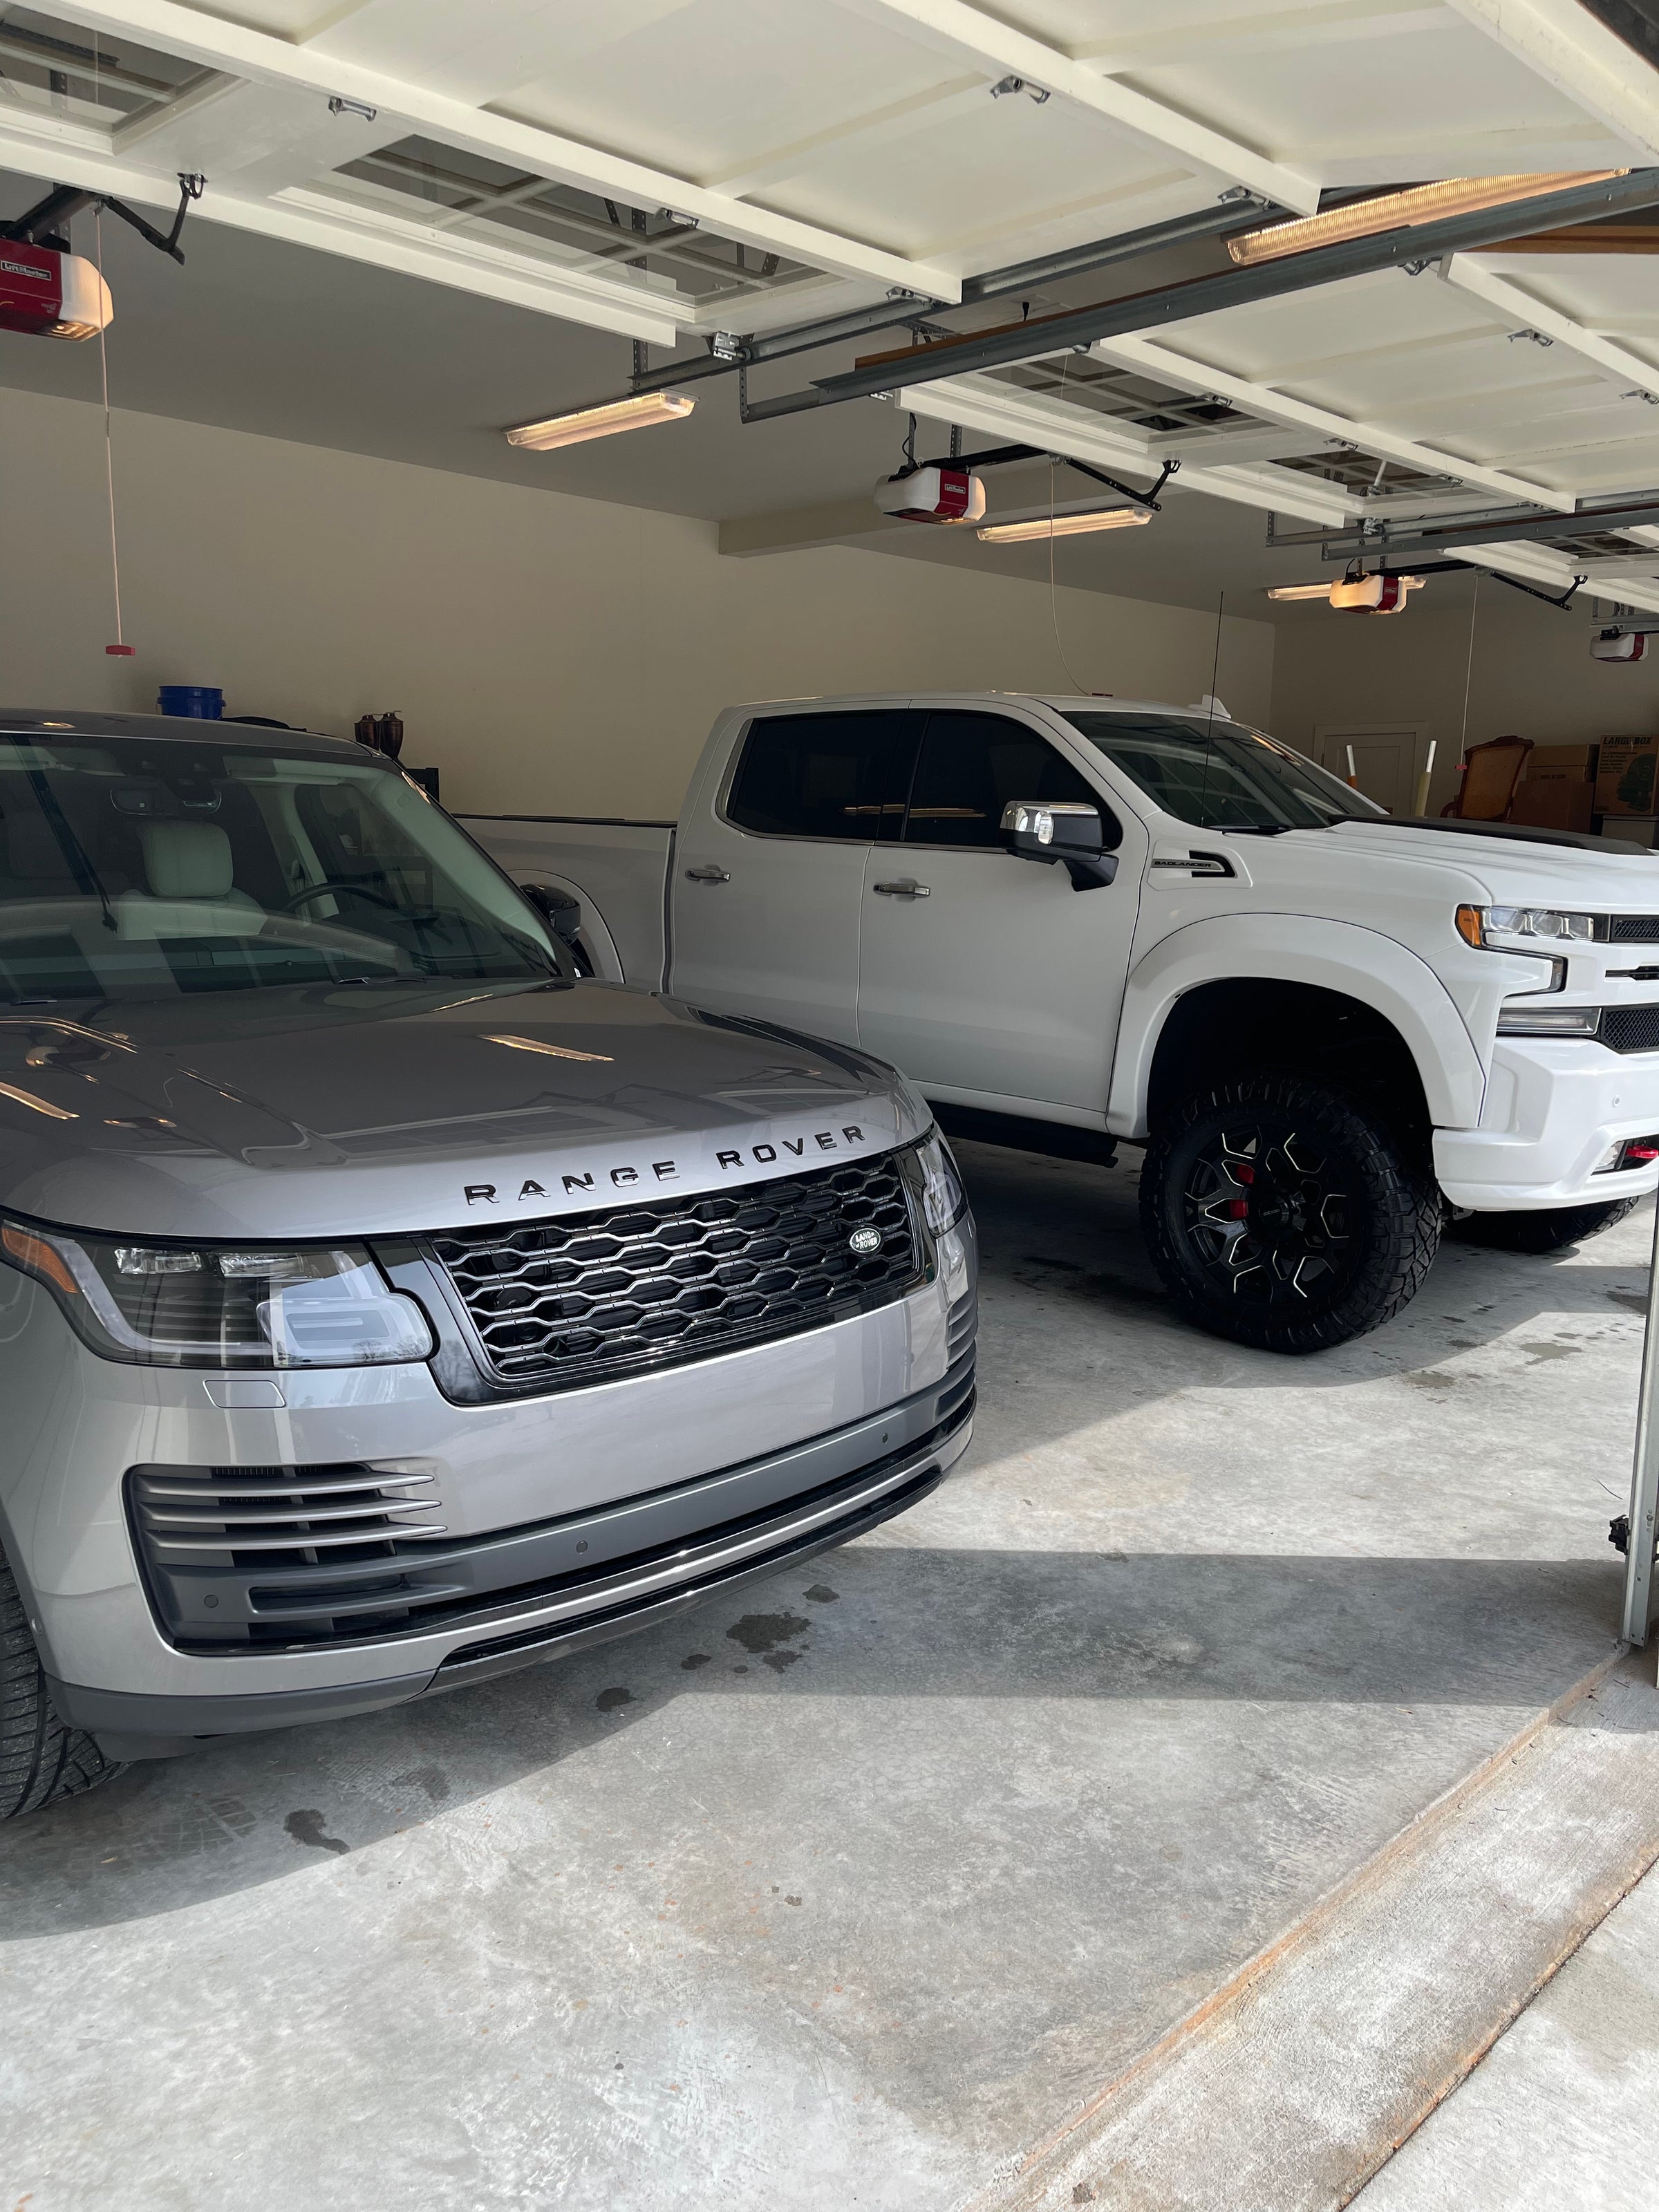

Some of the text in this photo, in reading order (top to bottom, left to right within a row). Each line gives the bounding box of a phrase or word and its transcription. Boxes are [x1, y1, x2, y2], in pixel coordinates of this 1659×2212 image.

[1603, 737, 1653, 745] LARGE BOX
[464, 1126, 866, 1206] RANGE ROVER
[855, 1231, 871, 1243] LAND
[859, 1237, 878, 1250] ROVER
